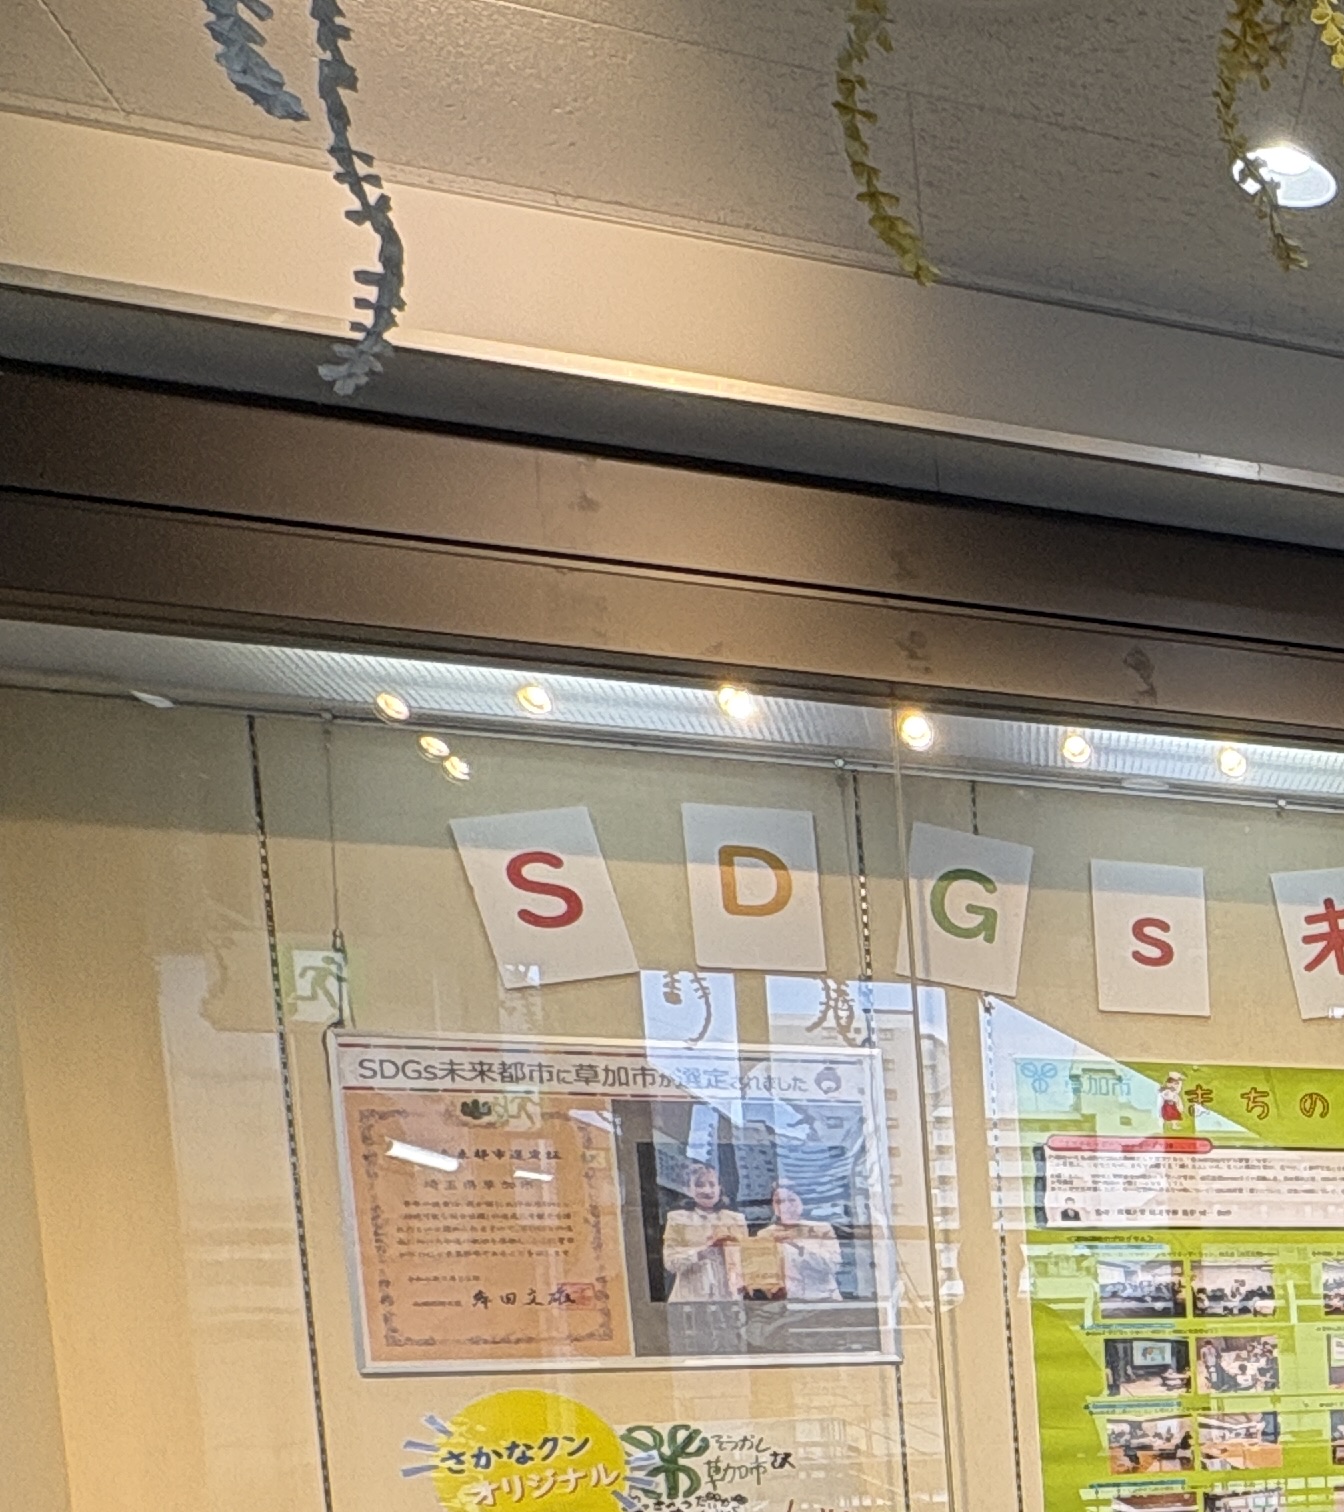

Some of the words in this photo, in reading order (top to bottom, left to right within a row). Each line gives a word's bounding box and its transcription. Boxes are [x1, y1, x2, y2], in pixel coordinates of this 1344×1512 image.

[440, 1434, 591, 1476] さかなクン
[468, 1461, 621, 1507] オリジナル
